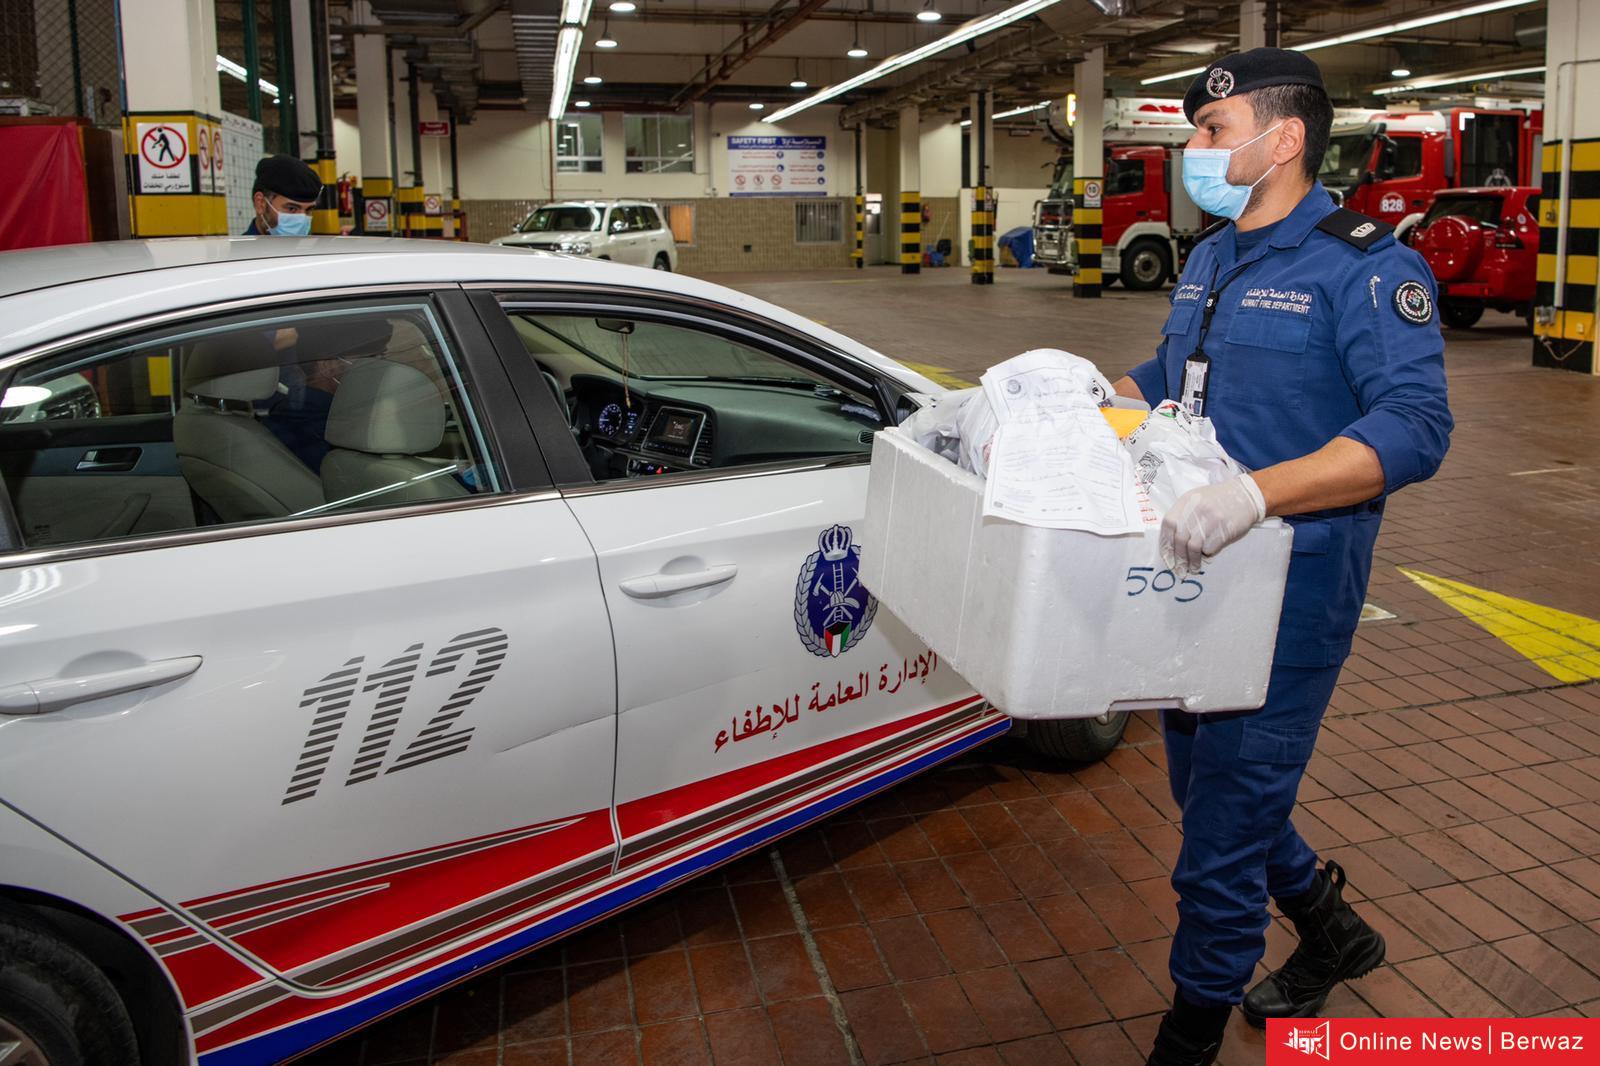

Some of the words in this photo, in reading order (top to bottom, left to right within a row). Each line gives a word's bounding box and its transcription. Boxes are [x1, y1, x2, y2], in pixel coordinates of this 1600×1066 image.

[731, 137, 757, 145] SAFETY
[758, 137, 777, 145] FIRST
[1382, 198, 1403, 212] 828
[1241, 298, 1259, 308] KUWAIT
[1259, 299, 1272, 309] FIRE
[1272, 301, 1311, 314] DEPARTMENT
[1270, 288, 1290, 299] العامة
[1290, 291, 1312, 304] الإدارة
[1126, 566, 1205, 603] 505
[878, 648, 938, 694] الإدارة
[807, 671, 870, 712] العامة
[281, 627, 508, 805] 112
[714, 694, 800, 754] للإطفاء
